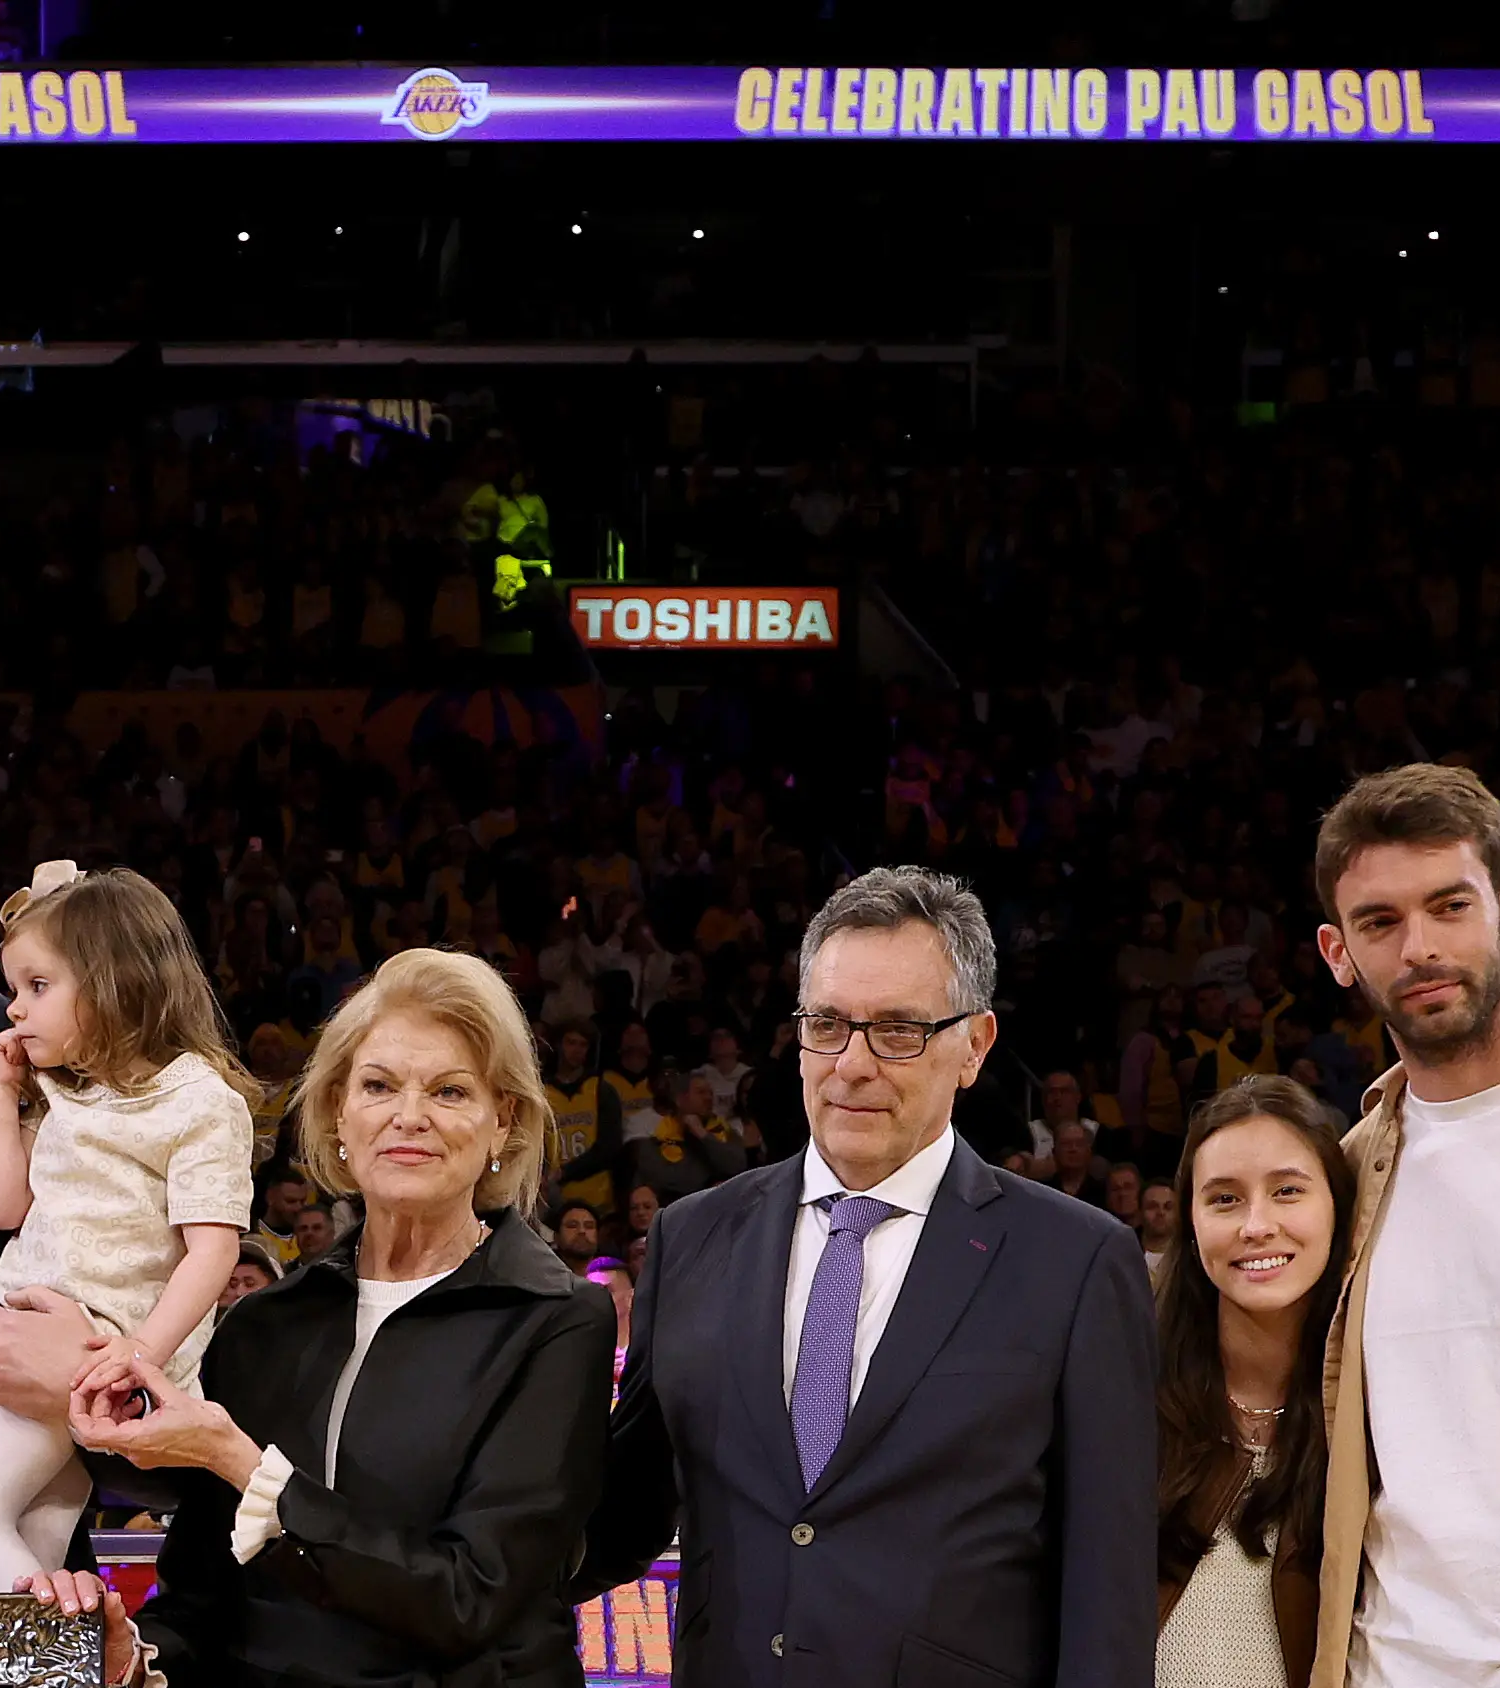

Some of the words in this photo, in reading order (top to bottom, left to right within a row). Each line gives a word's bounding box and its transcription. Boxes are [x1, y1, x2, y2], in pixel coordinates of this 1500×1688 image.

[392, 86, 483, 120] LAKERS
[735, 65, 1108, 134] CELEBRATING
[1128, 66, 1238, 134] PAU
[1255, 67, 1436, 134] GASOL
[575, 597, 835, 642] TOSHIBA
